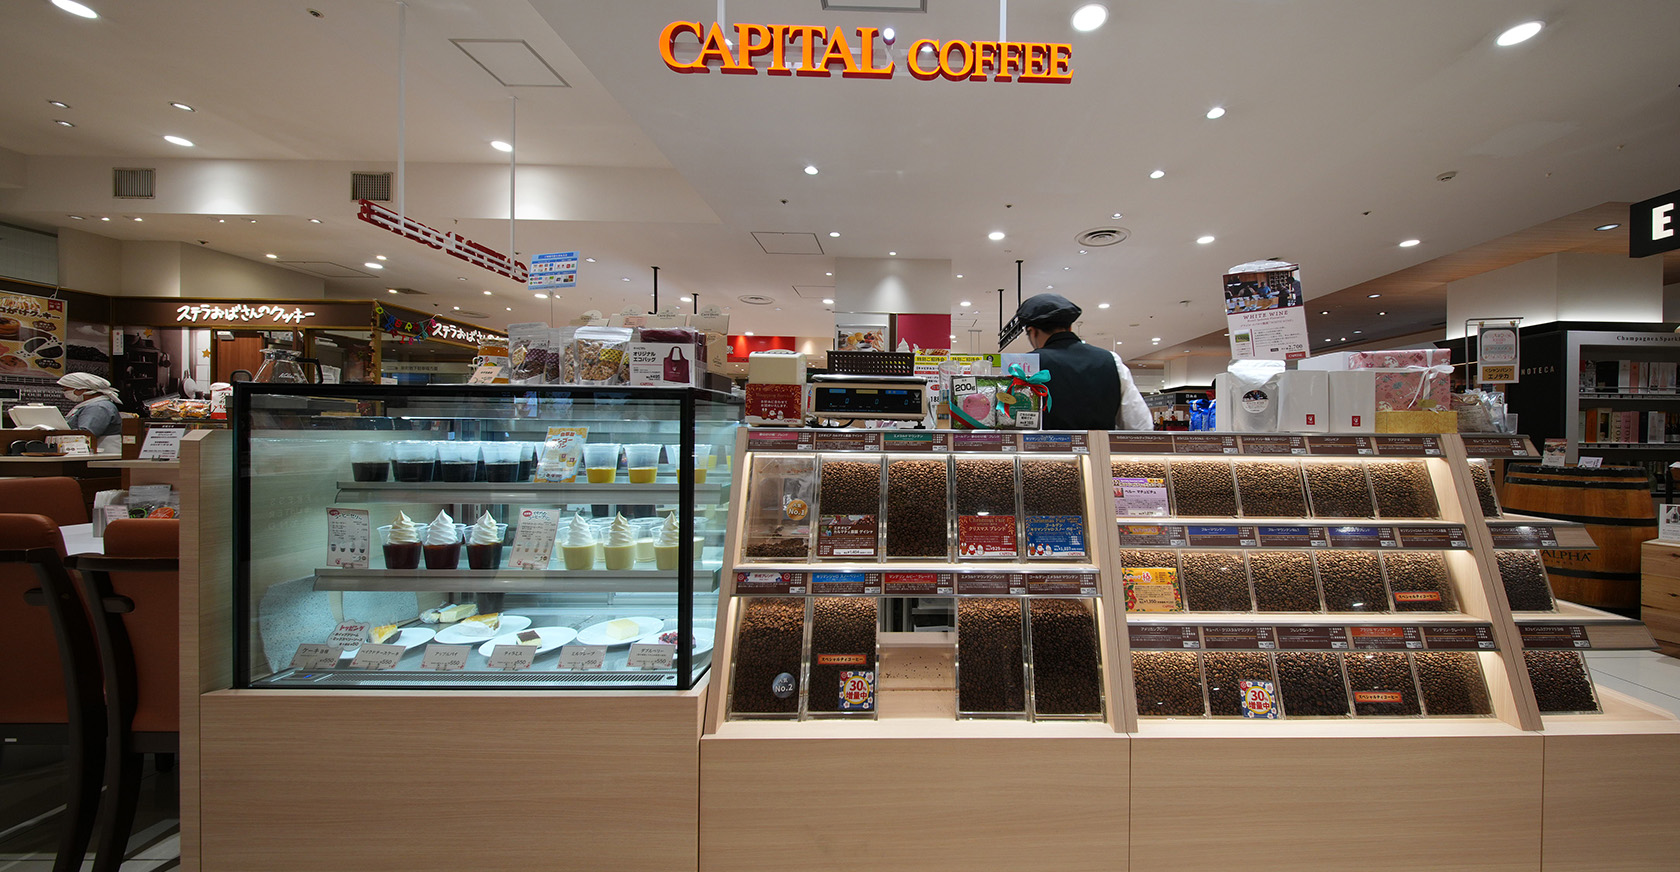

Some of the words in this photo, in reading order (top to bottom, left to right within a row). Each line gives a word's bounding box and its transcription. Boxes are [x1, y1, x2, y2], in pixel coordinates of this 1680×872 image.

[659, 20, 895, 79] CAPITAL
[907, 38, 1074, 84] COFFEE
[1651, 202, 1675, 241] E
[176, 303, 316, 324] ステラおばさんのクッキー
[788, 508, 805, 516] No.1
[1541, 549, 1591, 562] ALPHA
[775, 683, 793, 692] No.2
[846, 691, 868, 700] 増量中
[1248, 701, 1270, 711] 増量中
